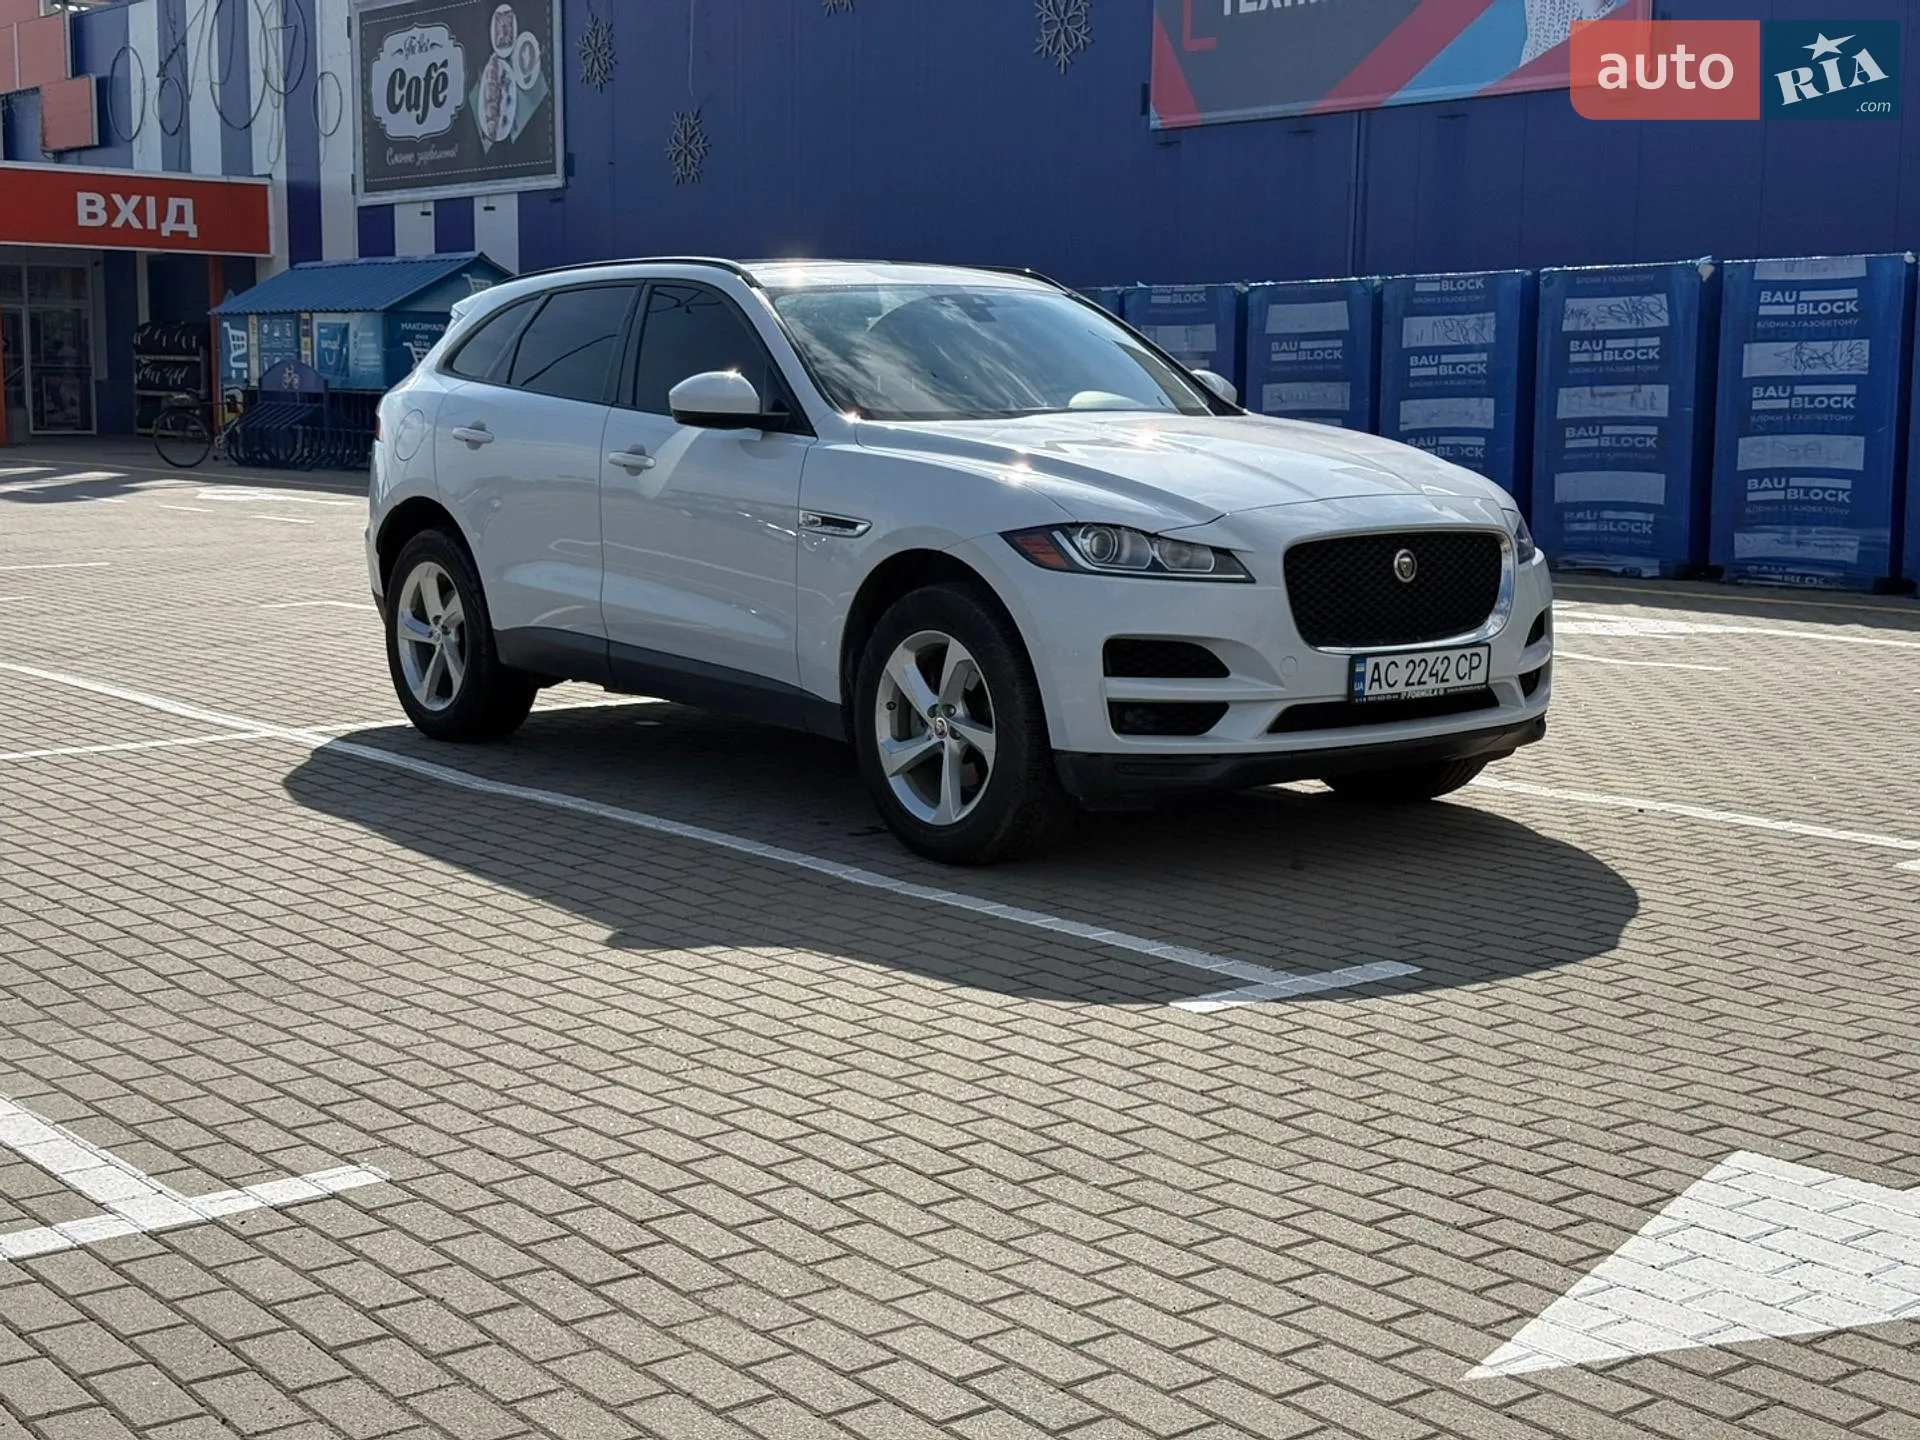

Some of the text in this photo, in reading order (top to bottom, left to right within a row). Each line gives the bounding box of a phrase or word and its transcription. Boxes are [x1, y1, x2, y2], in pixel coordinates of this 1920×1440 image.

[386, 59, 449, 125] Café
[76, 191, 198, 239] ВХІД
[1441, 278, 1485, 291] BLOCK
[1759, 290, 1797, 303] BAU
[1796, 300, 1859, 315] BLOCK
[1271, 341, 1298, 351] BAU
[1569, 340, 1603, 352] BAU
[1298, 349, 1343, 361] BLOCK
[1410, 355, 1438, 366] BAU
[1603, 347, 1661, 361] BLOCK
[1439, 363, 1487, 375] BLOCK
[1752, 385, 1790, 398] BAU
[1791, 396, 1856, 409] BLOCK
[1565, 426, 1600, 438] BAU
[1407, 436, 1437, 447] BAU
[1600, 436, 1658, 448] BLOCK
[1747, 477, 1786, 490] BAU
[1786, 488, 1852, 503] BLOCK
[1597, 520, 1653, 534] BLOCK
[1368, 652, 1482, 690] AC 2242 CP
